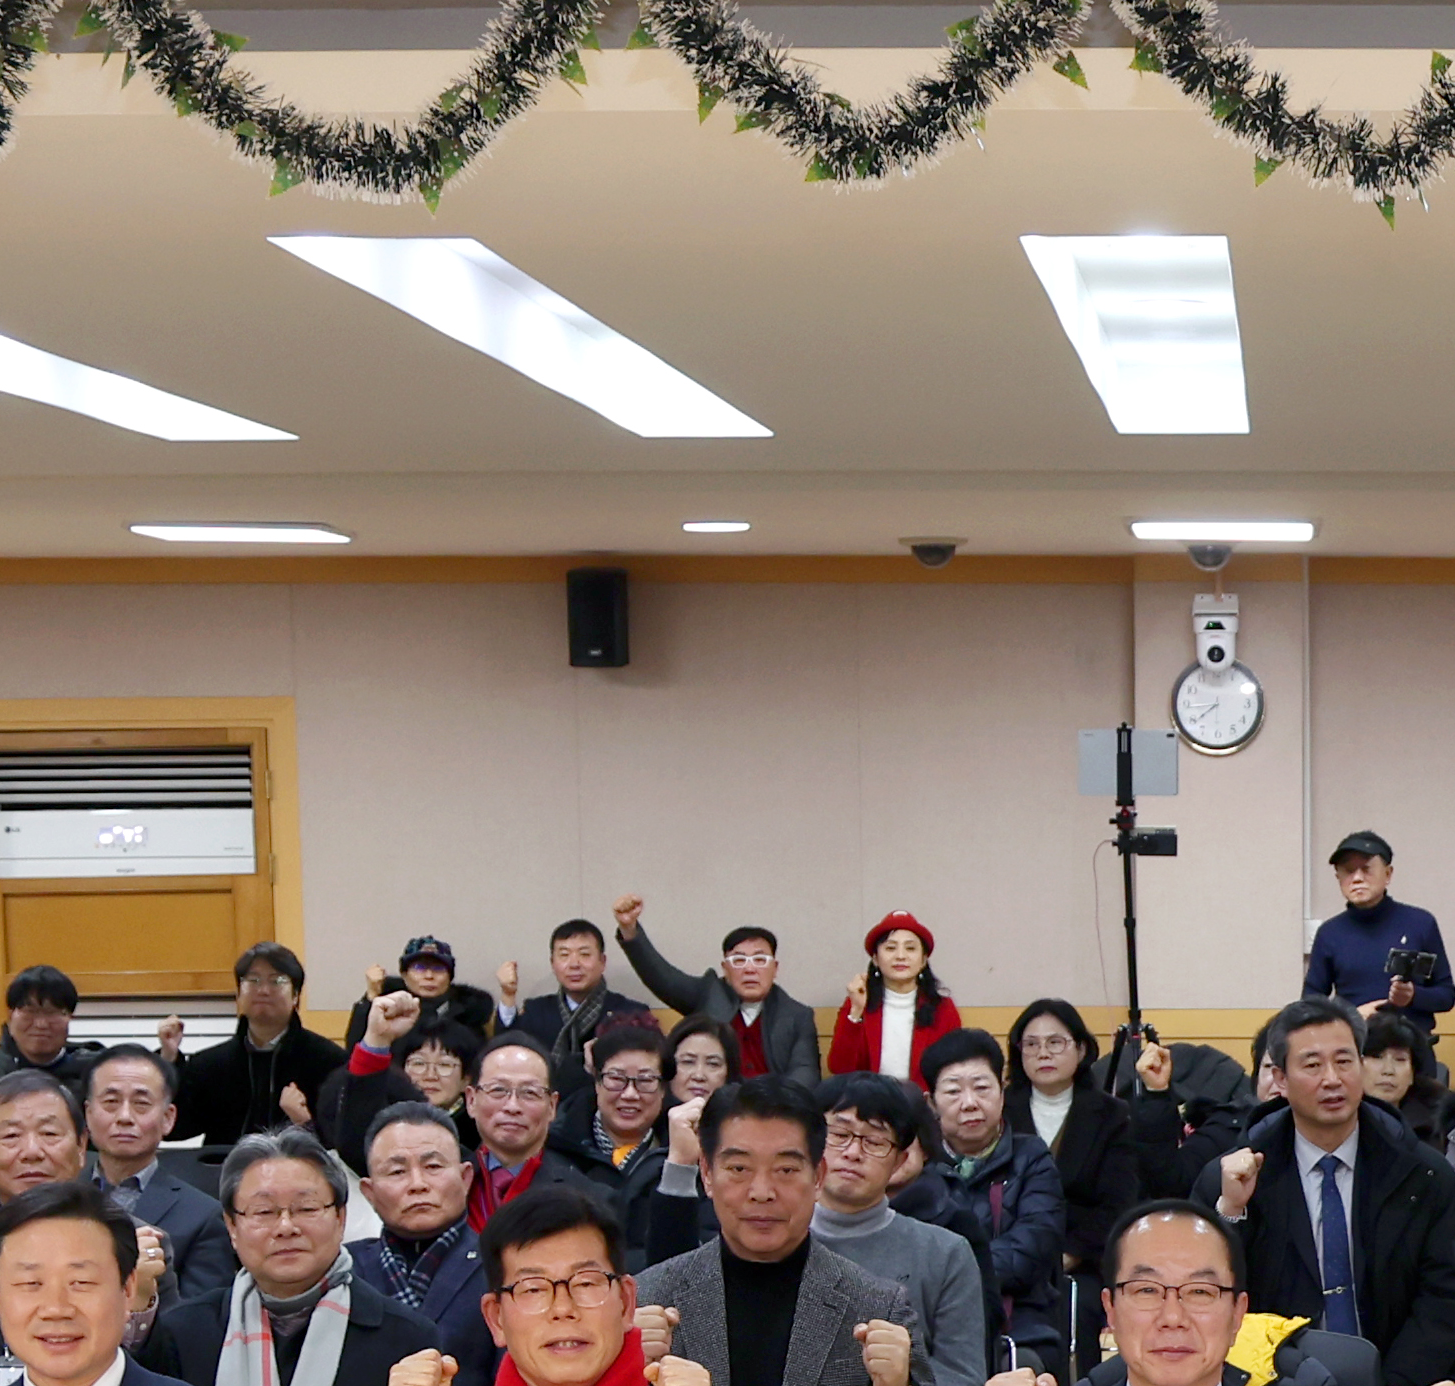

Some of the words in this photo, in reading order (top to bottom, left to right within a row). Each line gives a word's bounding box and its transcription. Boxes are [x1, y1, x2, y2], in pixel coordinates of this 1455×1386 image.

[1187, 685, 1198, 694] 10
[1244, 698, 1251, 709] 3
[1189, 715, 1197, 724] 8
[1238, 715, 1246, 725] 4
[1214, 729, 1222, 739] 6
[1229, 724, 1236, 734] 5
